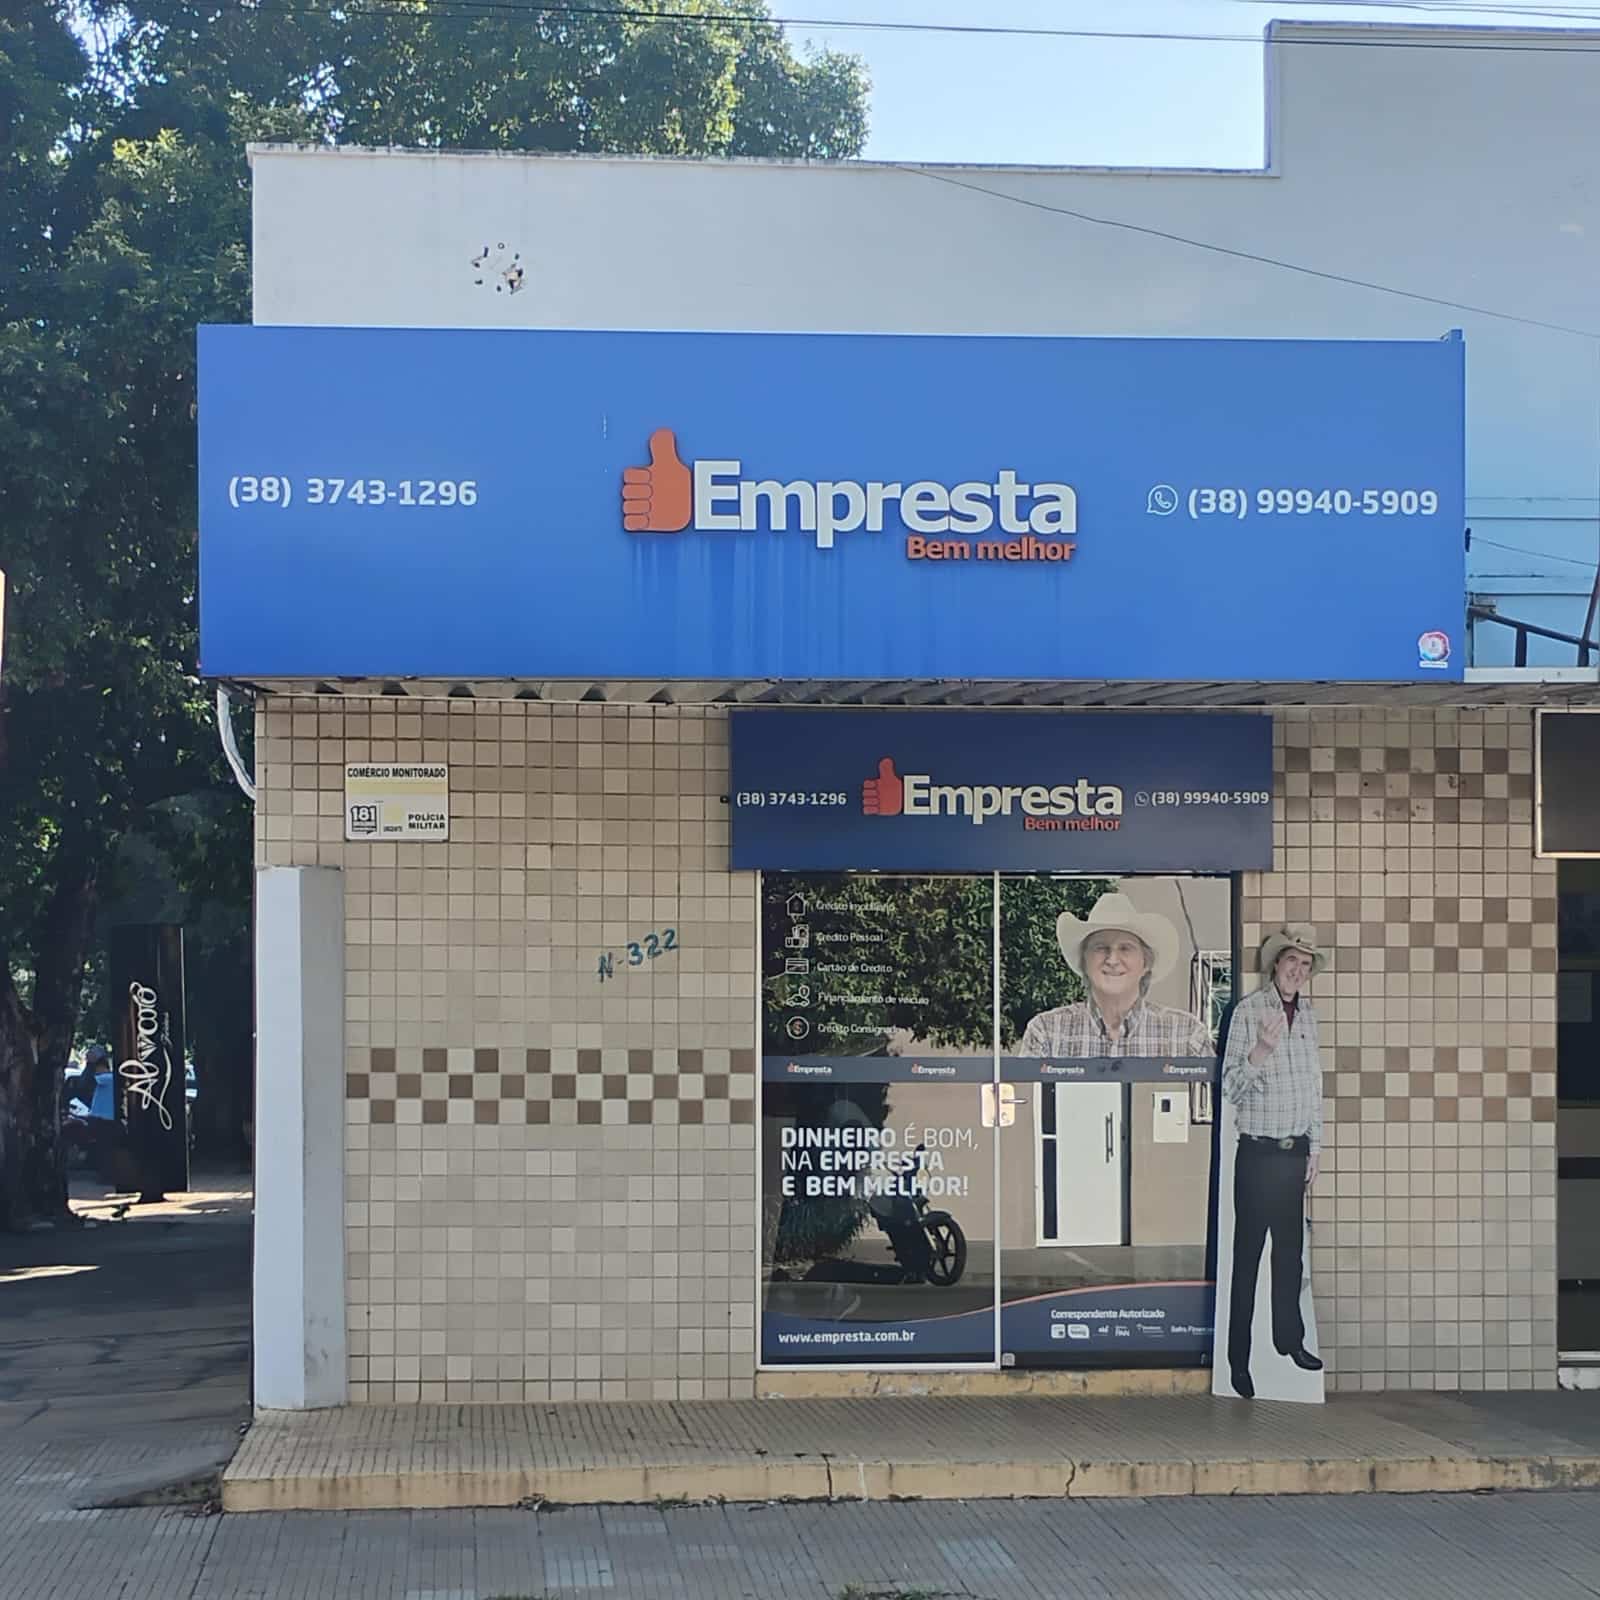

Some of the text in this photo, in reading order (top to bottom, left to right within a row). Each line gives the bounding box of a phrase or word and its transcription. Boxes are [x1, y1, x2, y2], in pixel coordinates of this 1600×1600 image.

[228, 476, 478, 507] (38) 3743-1296
[694, 460, 1077, 548] Empresta
[1188, 488, 1438, 519] (38) 99940-5909
[907, 536, 1076, 561] Bem melhor
[392, 767, 446, 778] MONITORADO
[736, 791, 847, 808] (38) 3743-1296
[903, 774, 1123, 825] Empresta
[1151, 791, 1270, 807] (38) 99940-5909
[351, 805, 377, 821] 181
[408, 822, 445, 830] MILITAR
[1024, 815, 1121, 831] Bem melhor
[793, 1065, 832, 1075] Empresta
[918, 1065, 956, 1075] Empresta
[1047, 1065, 1085, 1075] Empresta
[1168, 1065, 1207, 1075] Empresta
[781, 1127, 896, 1148] DINHEIRO
[924, 1128, 979, 1150] BOM,
[781, 1150, 945, 1171] NA EMPRESTA
[806, 1175, 855, 1196] BEM
[863, 1175, 969, 1196] MELHOR!
[1051, 1309, 1165, 1320] Correspondente Autorizado
[778, 1329, 915, 1345] www.empresta.com.br
